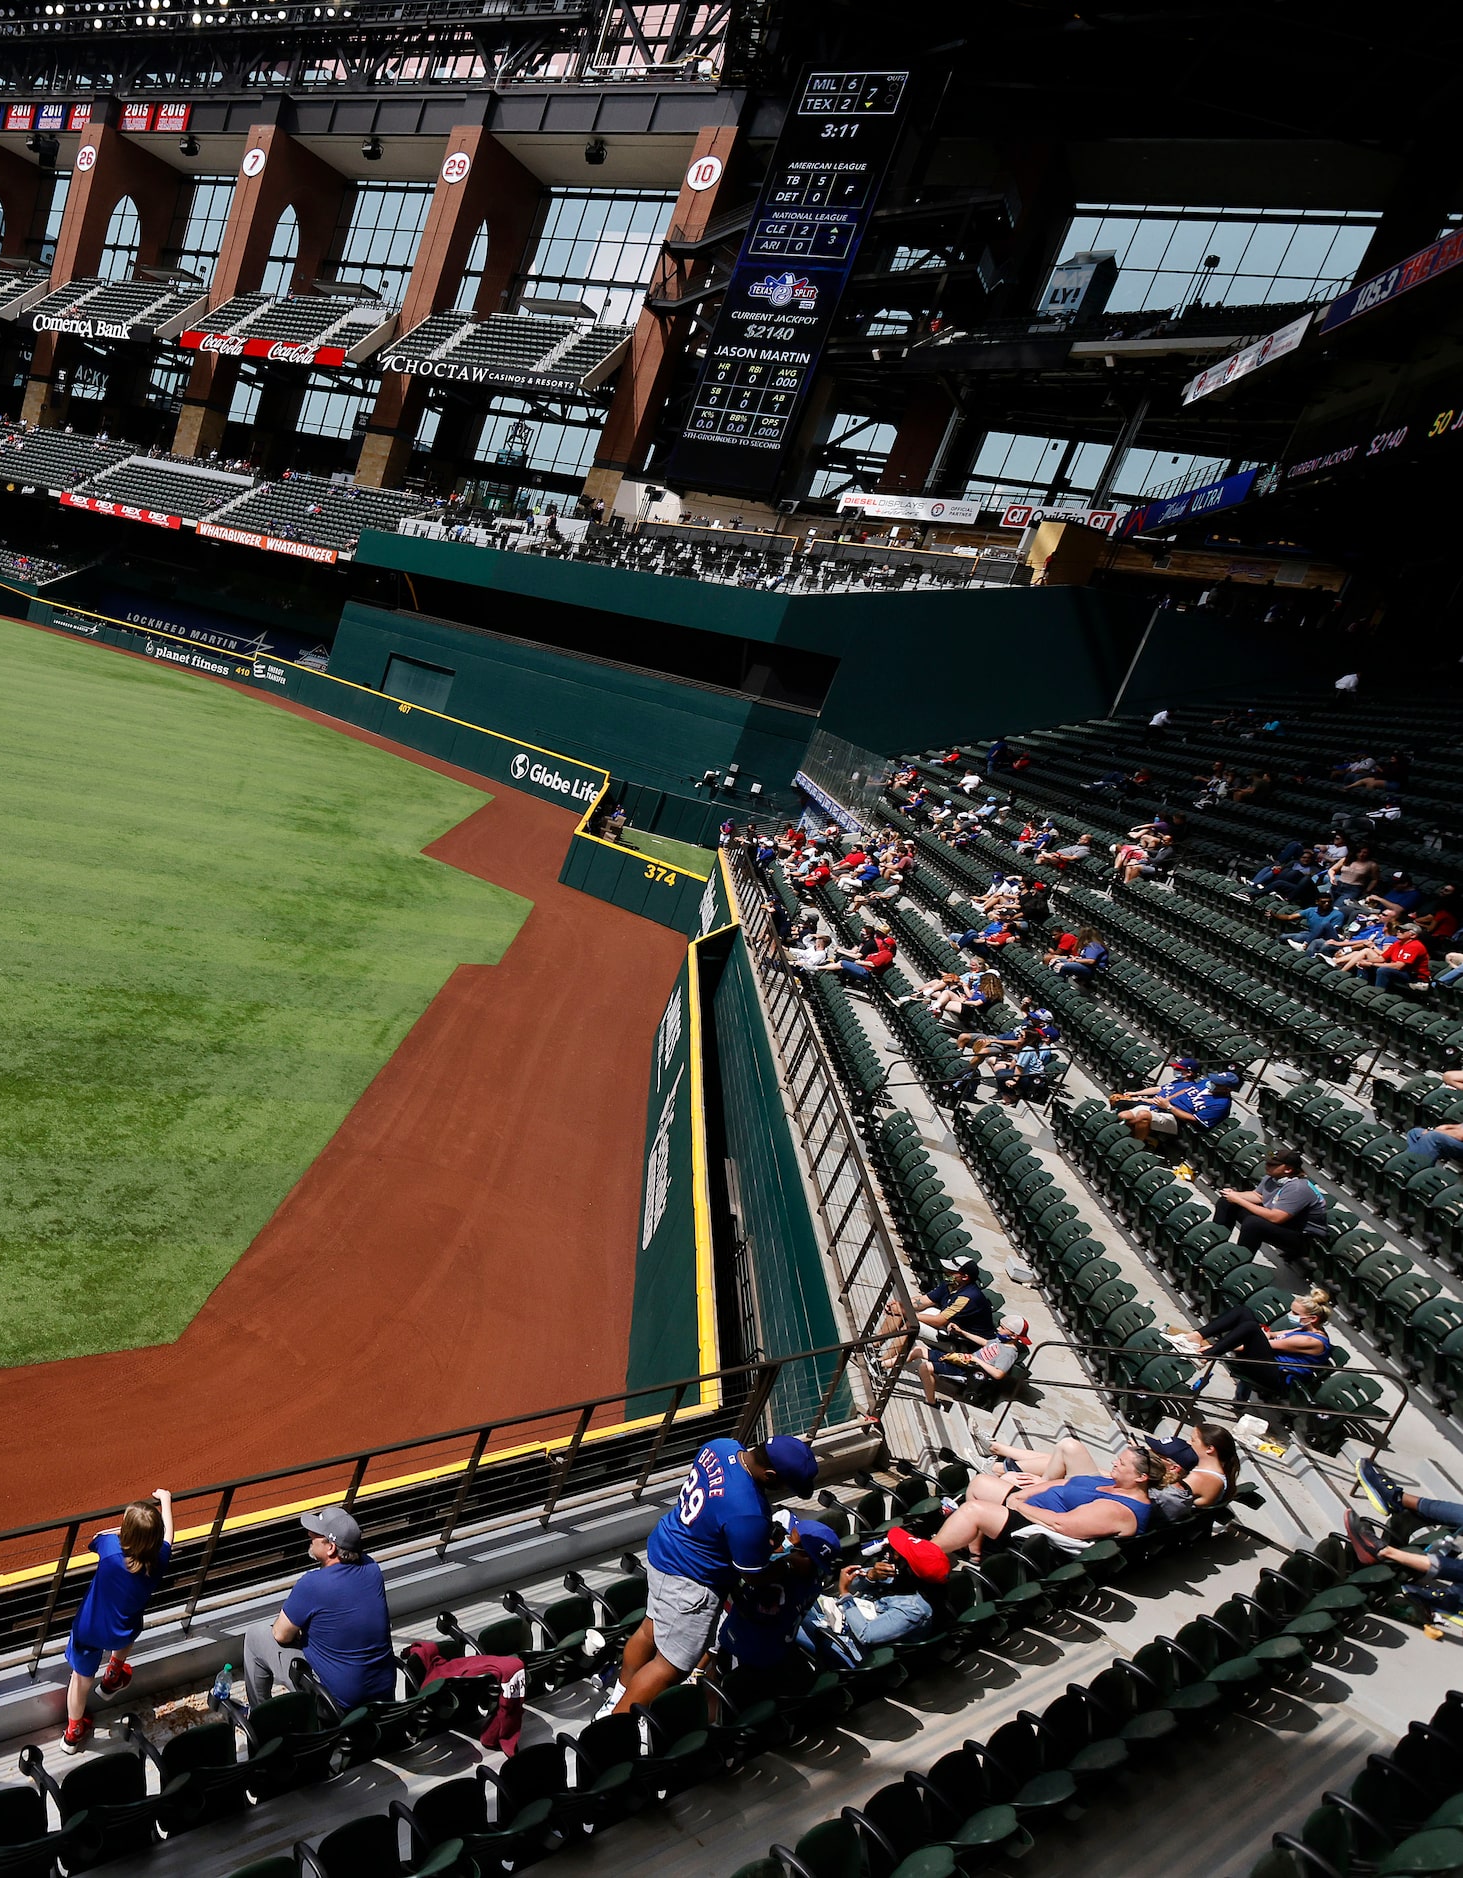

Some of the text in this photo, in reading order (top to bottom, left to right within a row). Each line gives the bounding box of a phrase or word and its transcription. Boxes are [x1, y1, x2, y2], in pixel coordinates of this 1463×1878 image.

[812, 78, 857, 90] MIL 6
[867, 88, 878, 99] 7
[124, 103, 149, 117] 2015
[160, 103, 186, 117] 2016
[805, 98, 850, 110] TEX 2
[11, 105, 31, 117] 2011
[41, 104, 62, 117] 2011
[820, 124, 860, 138] 3:11
[79, 151, 95, 166] 26
[249, 154, 260, 171] 7
[445, 159, 466, 177] 29
[788, 162, 867, 171] AMERICAN LEAGUE
[693, 163, 715, 184] 10
[786, 176, 826, 186] TB 5
[845, 185, 854, 195] F
[775, 192, 820, 202] DET 0
[772, 211, 848, 222] NATIONAL LEAGUE
[765, 224, 809, 235] CLE 2
[760, 240, 803, 251] ARI 0
[827, 235, 836, 245] 3
[1396, 244, 1440, 293] THE
[752, 286, 774, 295] TEXAS
[793, 288, 815, 297] SPLIT
[1049, 287, 1081, 304] LY!
[1350, 268, 1399, 316] 105.3
[731, 311, 818, 325] CURRENT JACKPOT
[94, 319, 132, 339] Bank
[744, 323, 795, 340] $2140
[714, 345, 811, 364] JASON MARTIN
[391, 355, 489, 382] CHOCTAW
[488, 373, 525, 384] CASINOS
[535, 378, 575, 389] RESORTS
[717, 363, 731, 371] HR
[748, 366, 763, 374] RBI
[778, 369, 797, 377] AVG
[717, 371, 726, 381] 0
[748, 374, 757, 384] 0
[772, 377, 797, 388] .000
[710, 387, 722, 395] SB
[742, 390, 752, 398] H
[709, 396, 717, 405] 0
[739, 399, 748, 409] 0
[771, 394, 786, 402] AB
[696, 418, 714, 429] 0.0
[726, 422, 744, 433] 0.0
[761, 418, 779, 426] OPS
[1428, 409, 1454, 438] 50
[754, 427, 779, 437] .000
[738, 438, 749, 446] TO
[750, 440, 781, 450] SECOND
[1366, 425, 1409, 457] $2140
[69, 494, 89, 505] DEX
[95, 500, 116, 510] DEX
[1191, 486, 1224, 512] ULTRA
[121, 505, 142, 516] DEX
[148, 511, 169, 522] DEX
[1007, 508, 1028, 523] QT
[1089, 514, 1112, 529] QT
[199, 523, 262, 547] WHATABURGER
[266, 537, 333, 562] WHATABURGER
[127, 612, 237, 650] LOCKHEED MARTIN
[154, 646, 229, 676] planet fitness
[235, 666, 250, 677] 410
[267, 665, 285, 676] ENERGY
[266, 672, 286, 685] TRANSFER
[398, 703, 411, 714] 407
[530, 763, 599, 804] Globe Life
[644, 864, 677, 887] 374
[1184, 1086, 1207, 1111] TEXAS
[698, 1447, 725, 1498] BELTRE
[679, 1469, 705, 1527] 29
